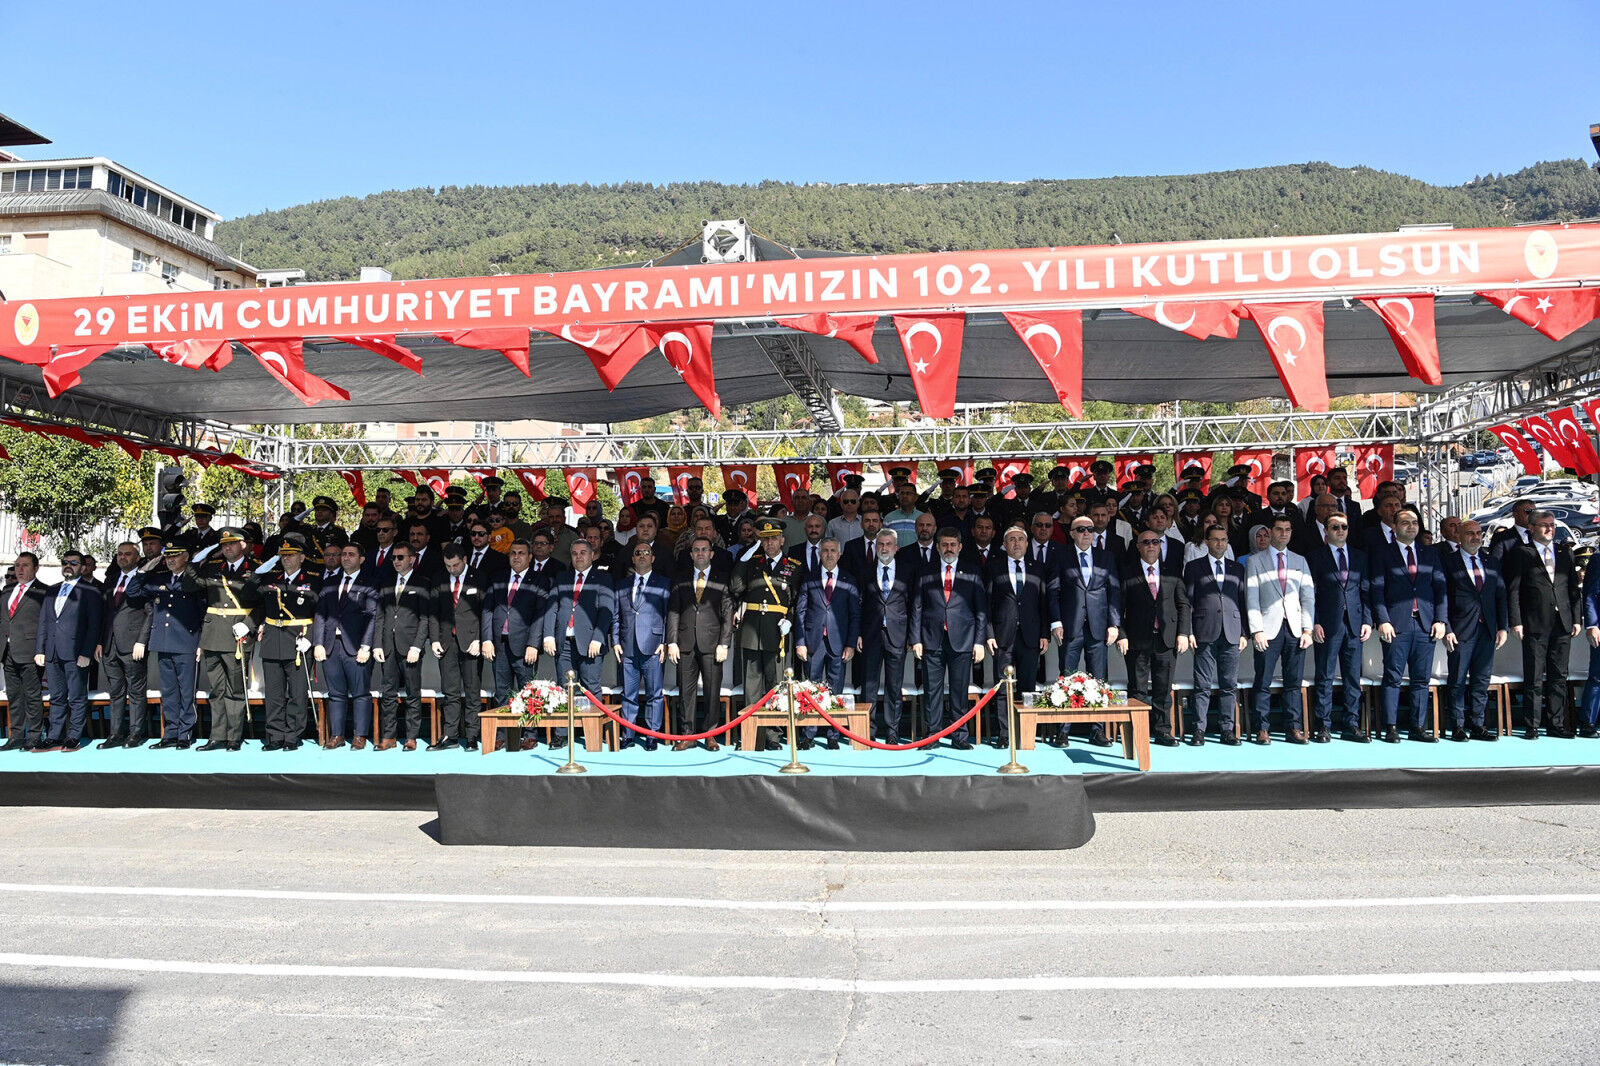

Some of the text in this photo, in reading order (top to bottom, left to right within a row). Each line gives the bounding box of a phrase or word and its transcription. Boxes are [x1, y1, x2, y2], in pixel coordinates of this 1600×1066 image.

[74, 307, 116, 337] 29
[912, 263, 1008, 298] 102.
[1021, 258, 1115, 293] YILI
[1132, 249, 1293, 288] KUTLU
[1307, 241, 1481, 280] OLSUN
